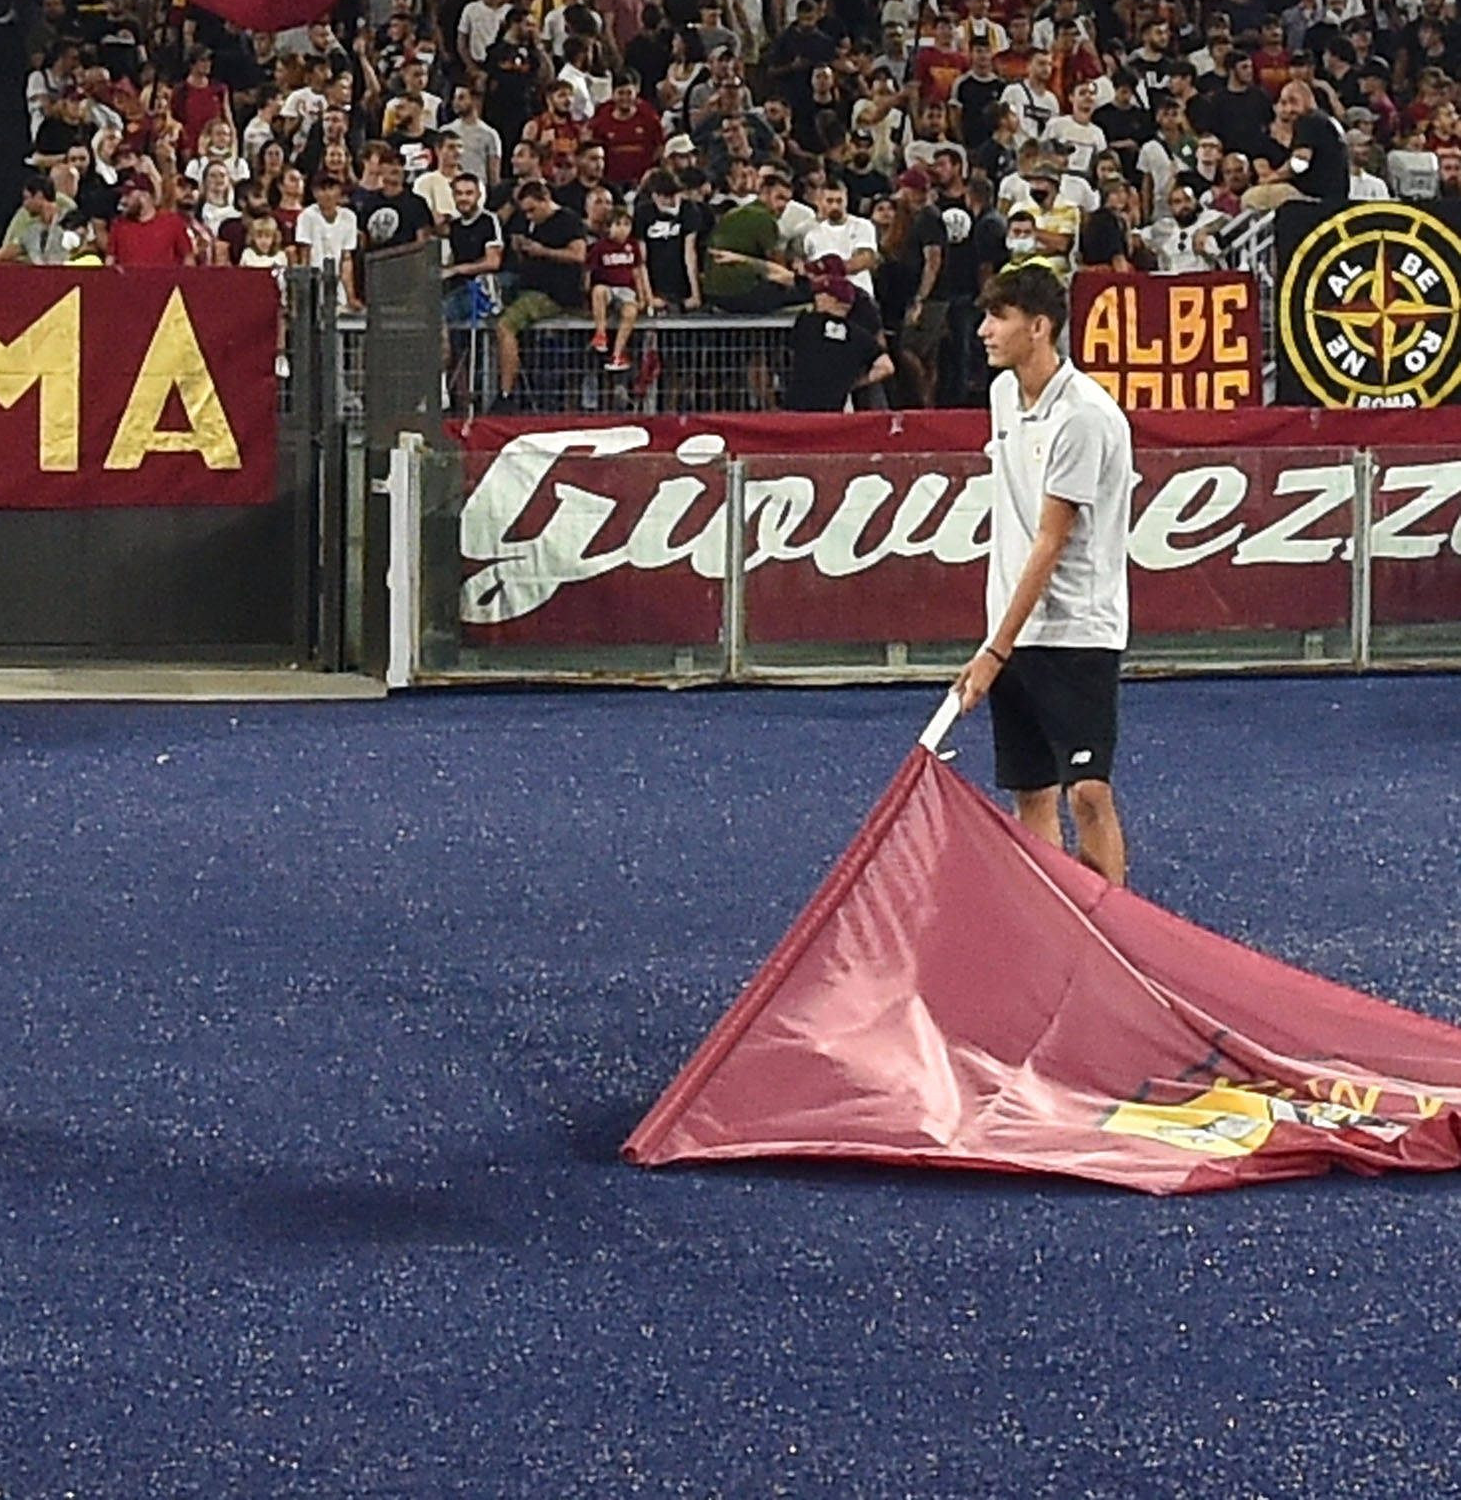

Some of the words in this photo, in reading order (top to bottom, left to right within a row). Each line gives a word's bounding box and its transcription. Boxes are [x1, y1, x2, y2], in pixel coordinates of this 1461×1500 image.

[1328, 260, 1364, 298] AL
[1400, 252, 1440, 294] BE
[1083, 284, 1249, 365] ALBE
